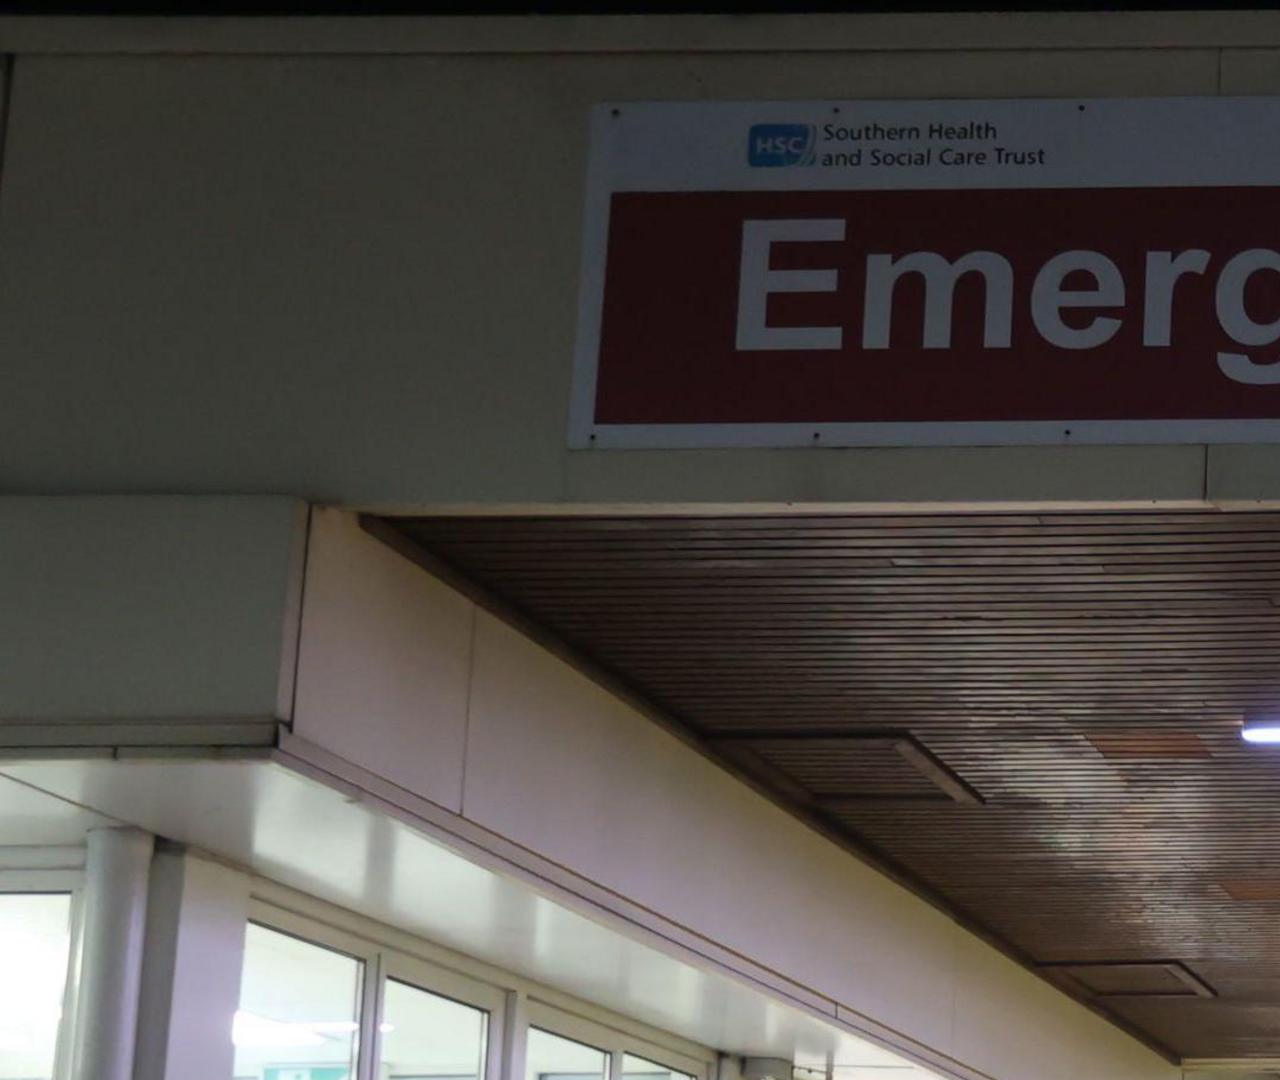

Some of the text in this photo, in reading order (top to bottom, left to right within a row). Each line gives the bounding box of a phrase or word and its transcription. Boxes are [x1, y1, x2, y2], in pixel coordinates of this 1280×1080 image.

[823, 121, 997, 141] Southern Health
[757, 138, 803, 151] HSC
[821, 147, 1046, 166] and Social Care Trust
